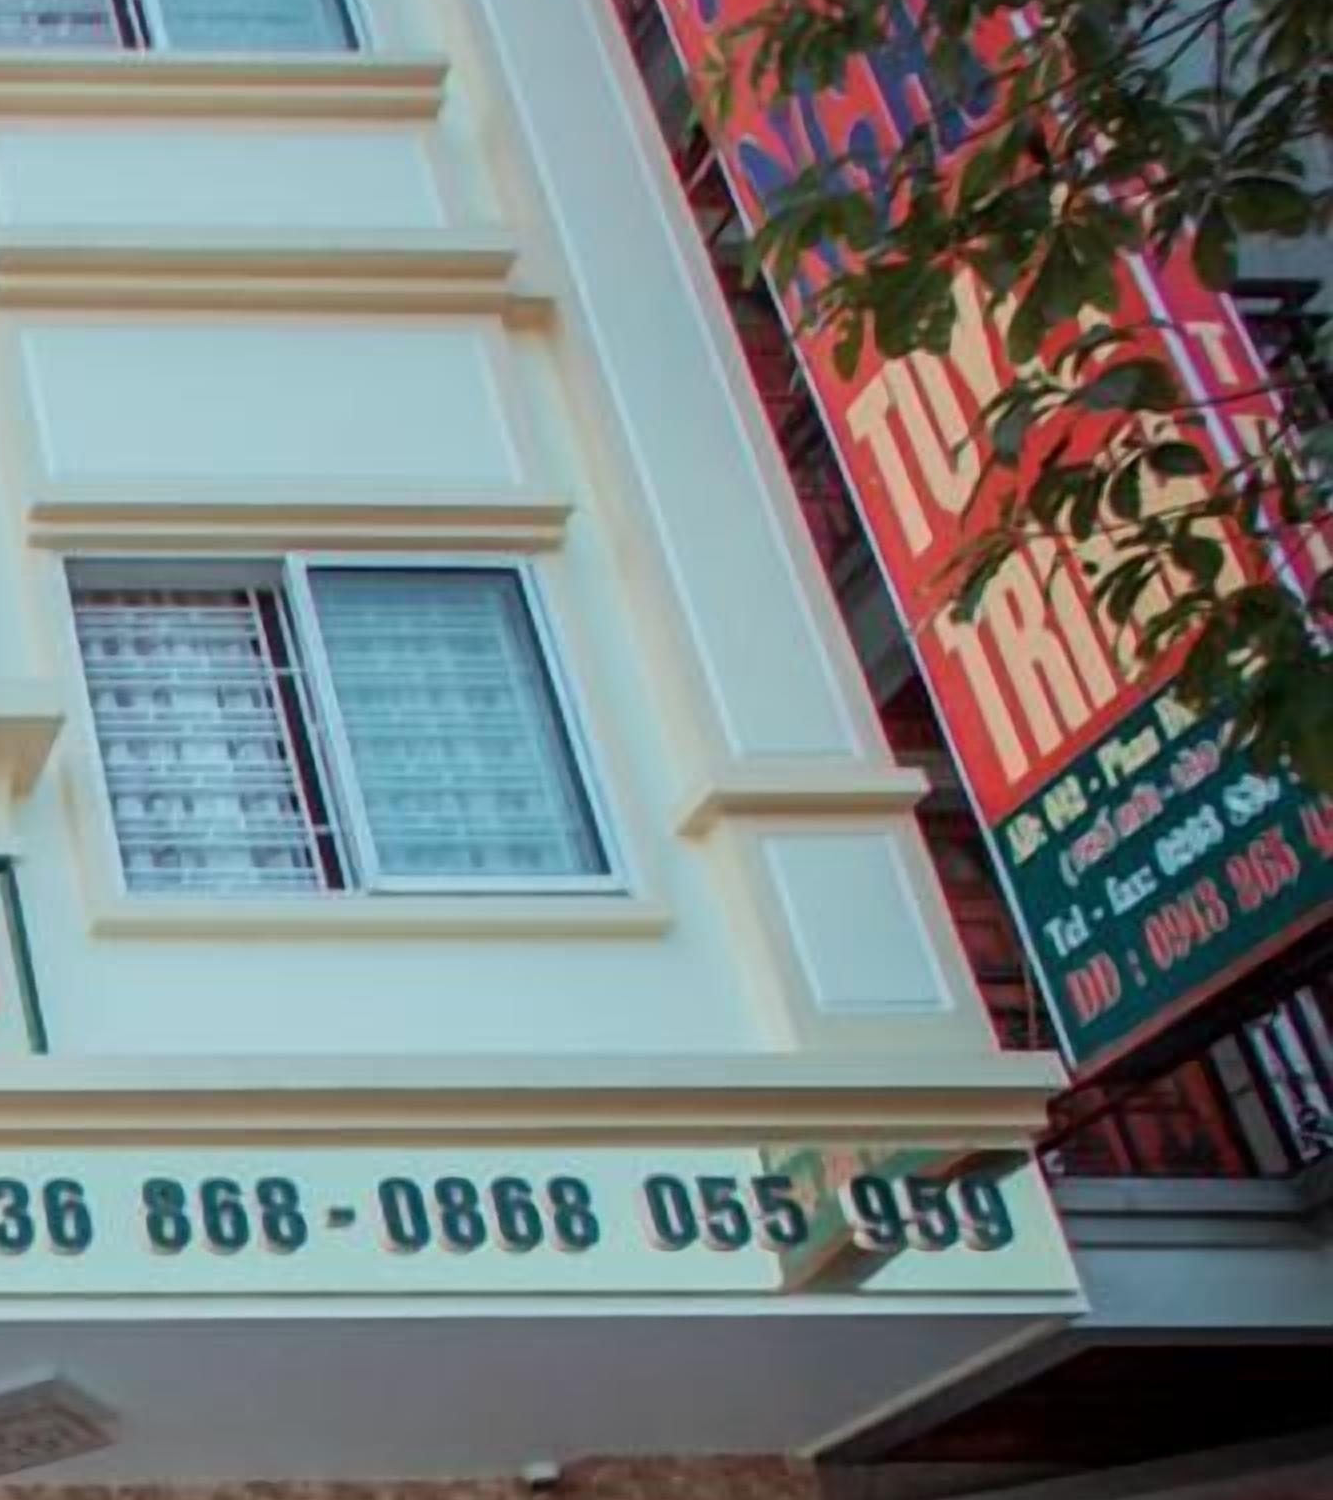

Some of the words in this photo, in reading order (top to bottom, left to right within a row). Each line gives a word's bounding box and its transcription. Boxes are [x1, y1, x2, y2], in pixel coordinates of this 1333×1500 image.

[140, 1175, 311, 1257] 868
[376, 1174, 603, 1254] 0868
[642, 1173, 811, 1254] 055
[844, 1173, 1015, 1254] 959
